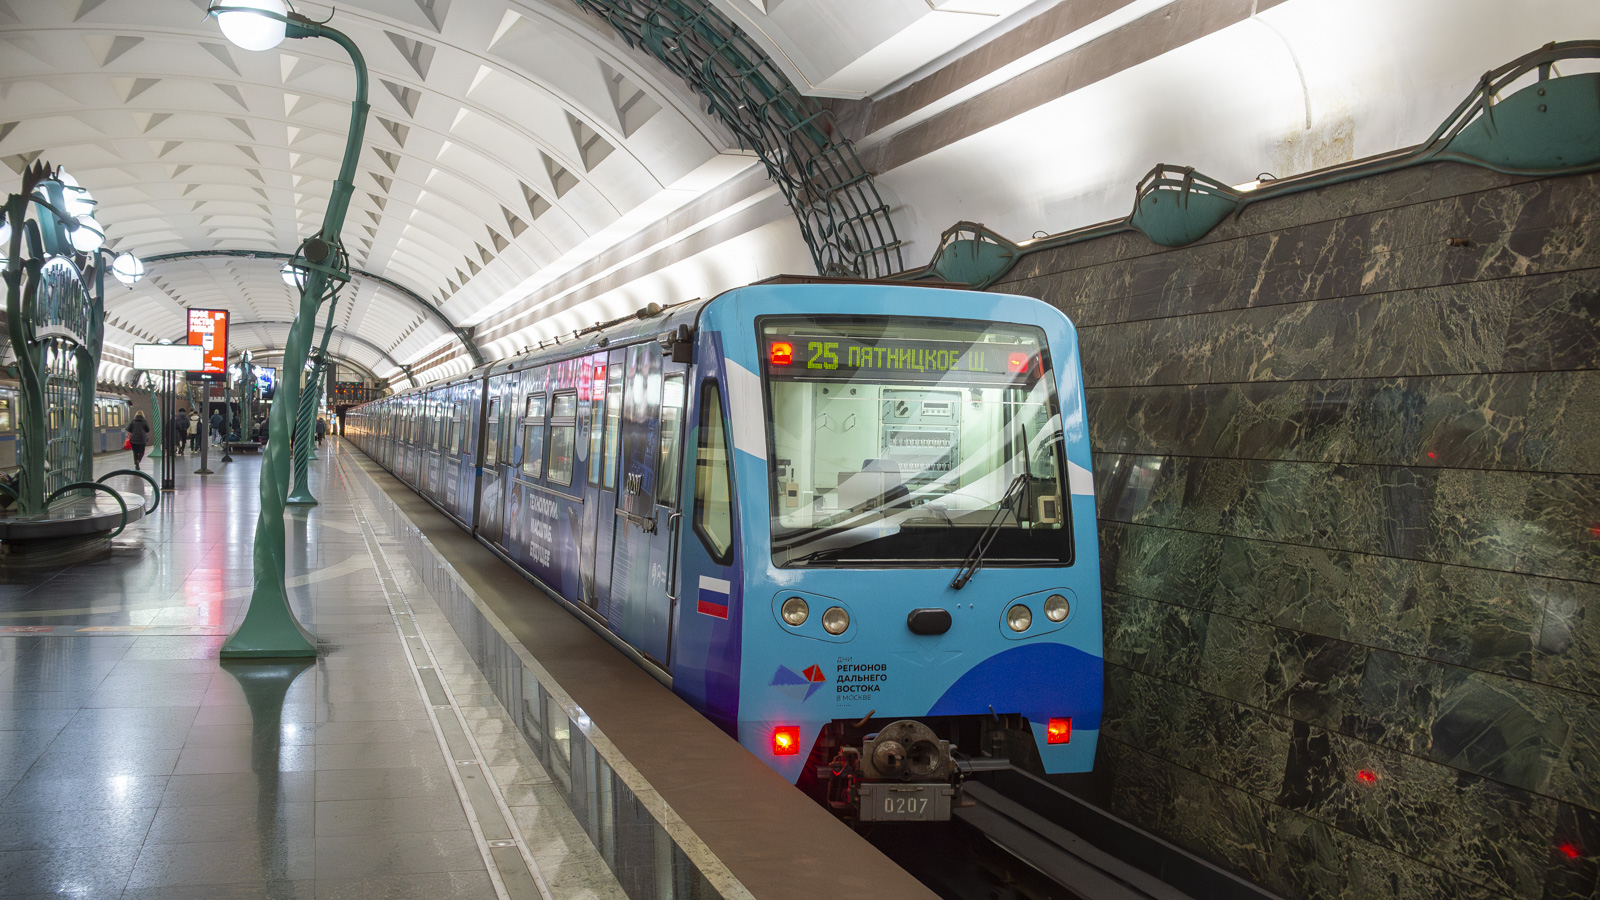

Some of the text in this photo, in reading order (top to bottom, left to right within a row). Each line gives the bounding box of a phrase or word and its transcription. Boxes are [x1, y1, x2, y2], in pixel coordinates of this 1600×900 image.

[807, 341, 989, 373] 25 ПЯТНИЦКОЕ Ш.
[836, 664, 887, 672] РЕГИОНОВ
[836, 674, 888, 684] ДАЛЬНЕГО
[836, 684, 881, 693] ВОСТОКА
[884, 797, 928, 814] 0207
